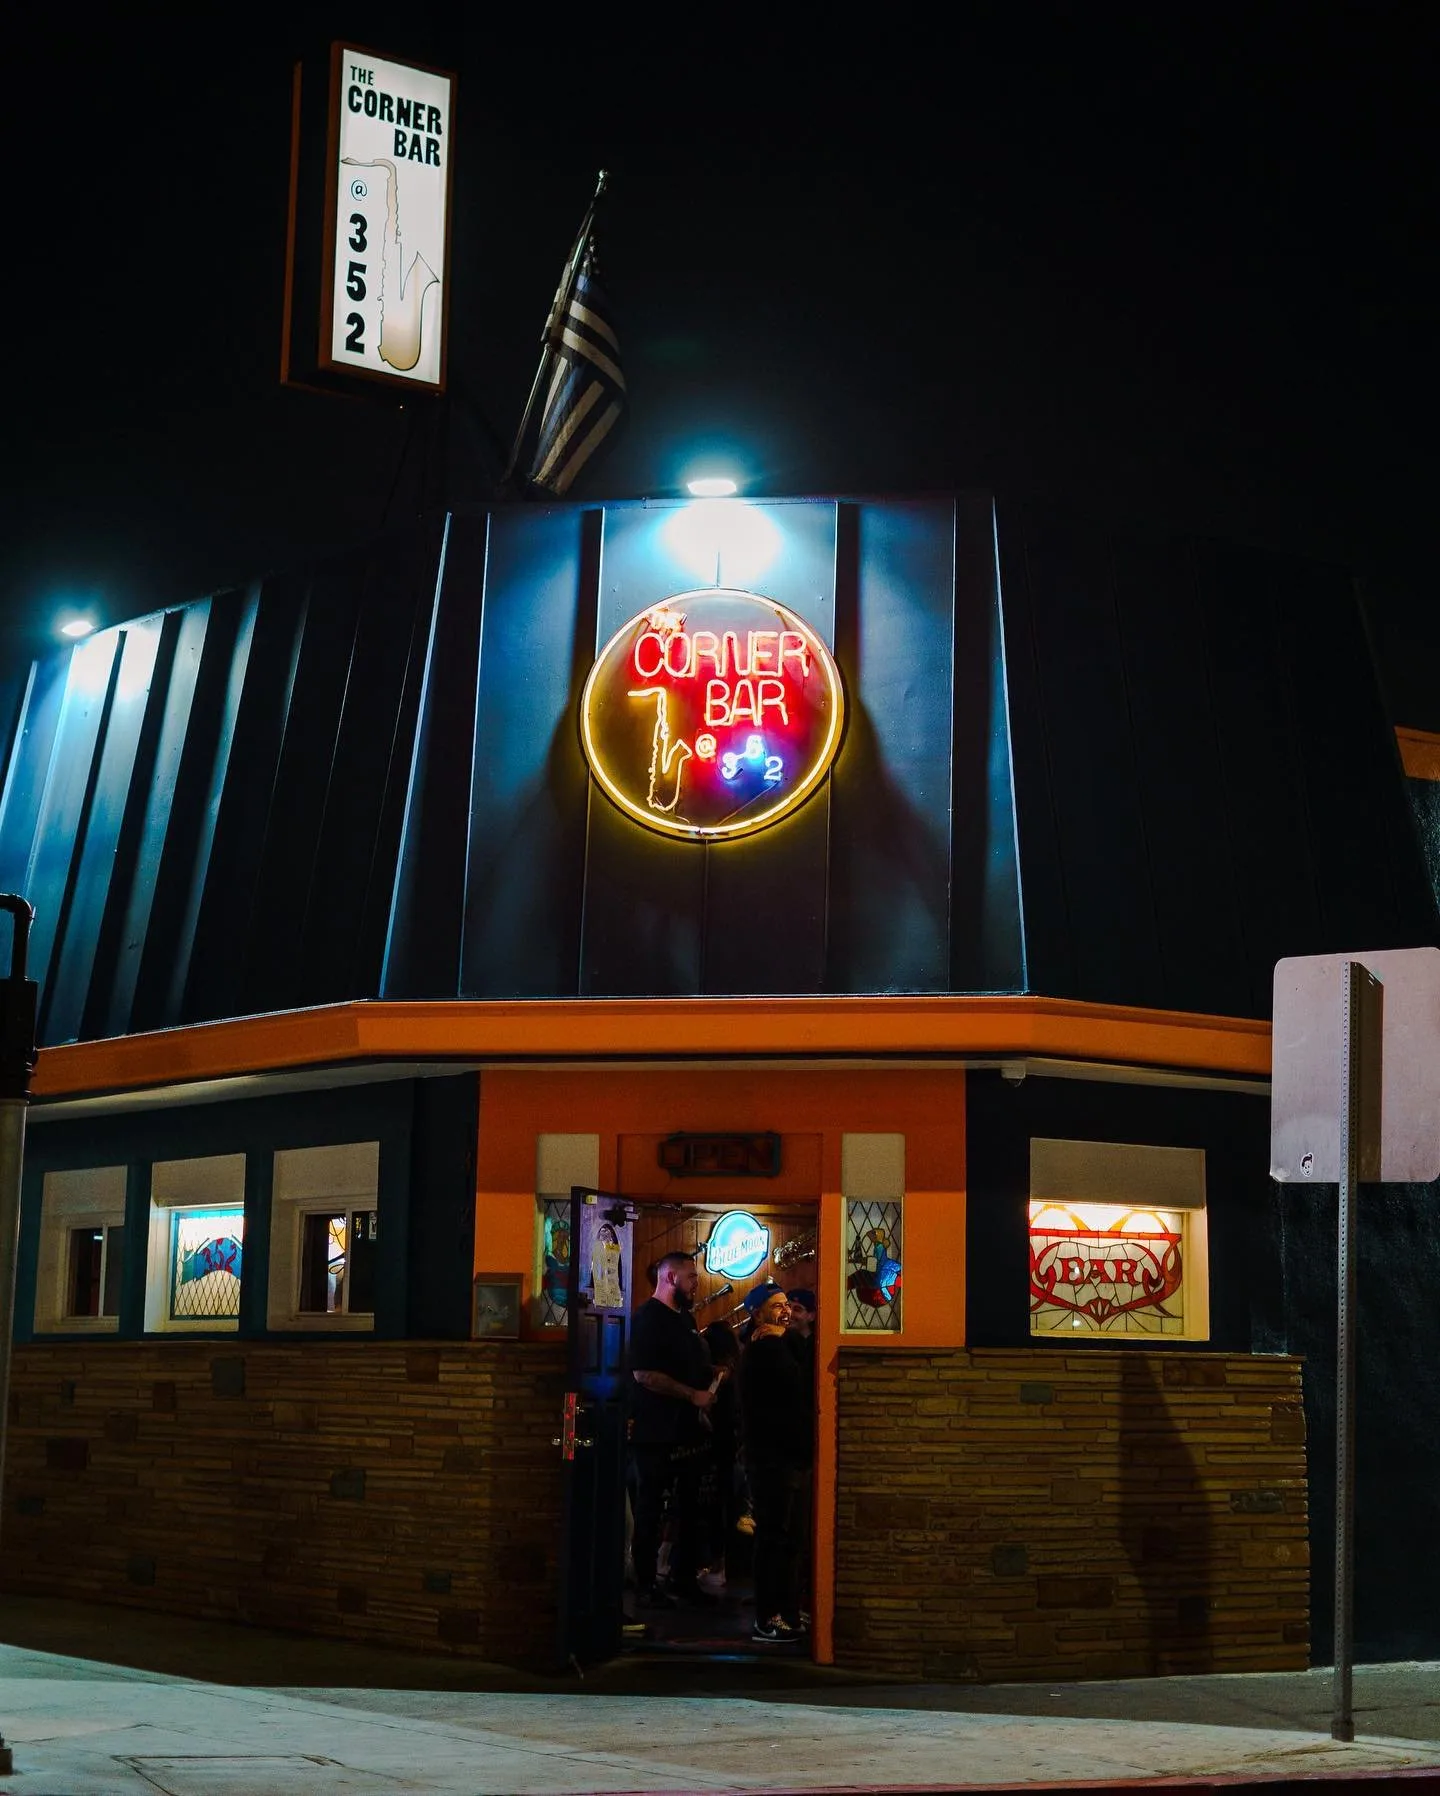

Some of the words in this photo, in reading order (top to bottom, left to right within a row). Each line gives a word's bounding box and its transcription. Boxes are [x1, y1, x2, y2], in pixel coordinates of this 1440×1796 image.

[350, 65, 374, 86] THE
[347, 85, 443, 135] CORNER
[393, 129, 441, 167] BAR
[350, 179, 368, 201] @
[634, 631, 809, 678] CORNER
[705, 680, 789, 726] BAR
[695, 734, 717, 758] @
[1056, 1257, 1143, 1286] BAR
